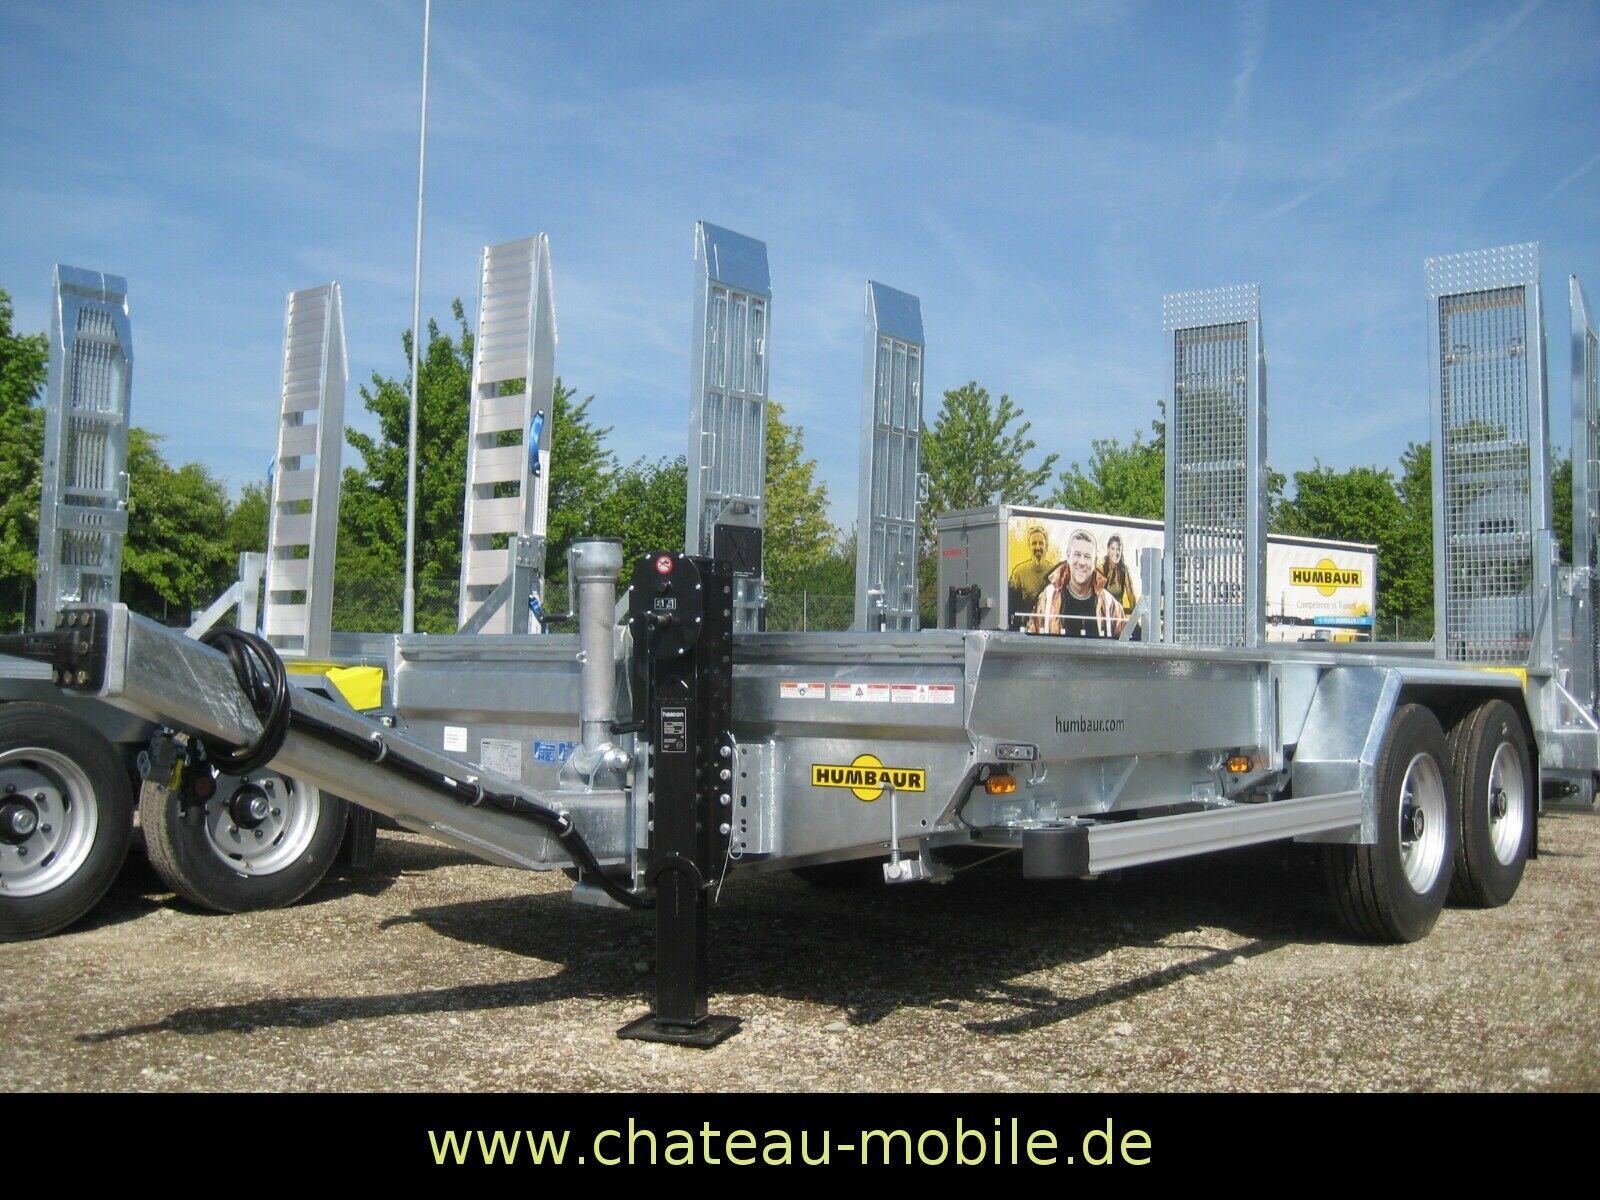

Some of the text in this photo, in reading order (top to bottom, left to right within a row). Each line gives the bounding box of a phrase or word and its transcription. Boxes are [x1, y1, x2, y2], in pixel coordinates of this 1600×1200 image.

[1293, 570, 1360, 585] HUMBAUR
[1055, 715, 1125, 733] humbaur.com
[816, 768, 922, 788] HUMBAUR
